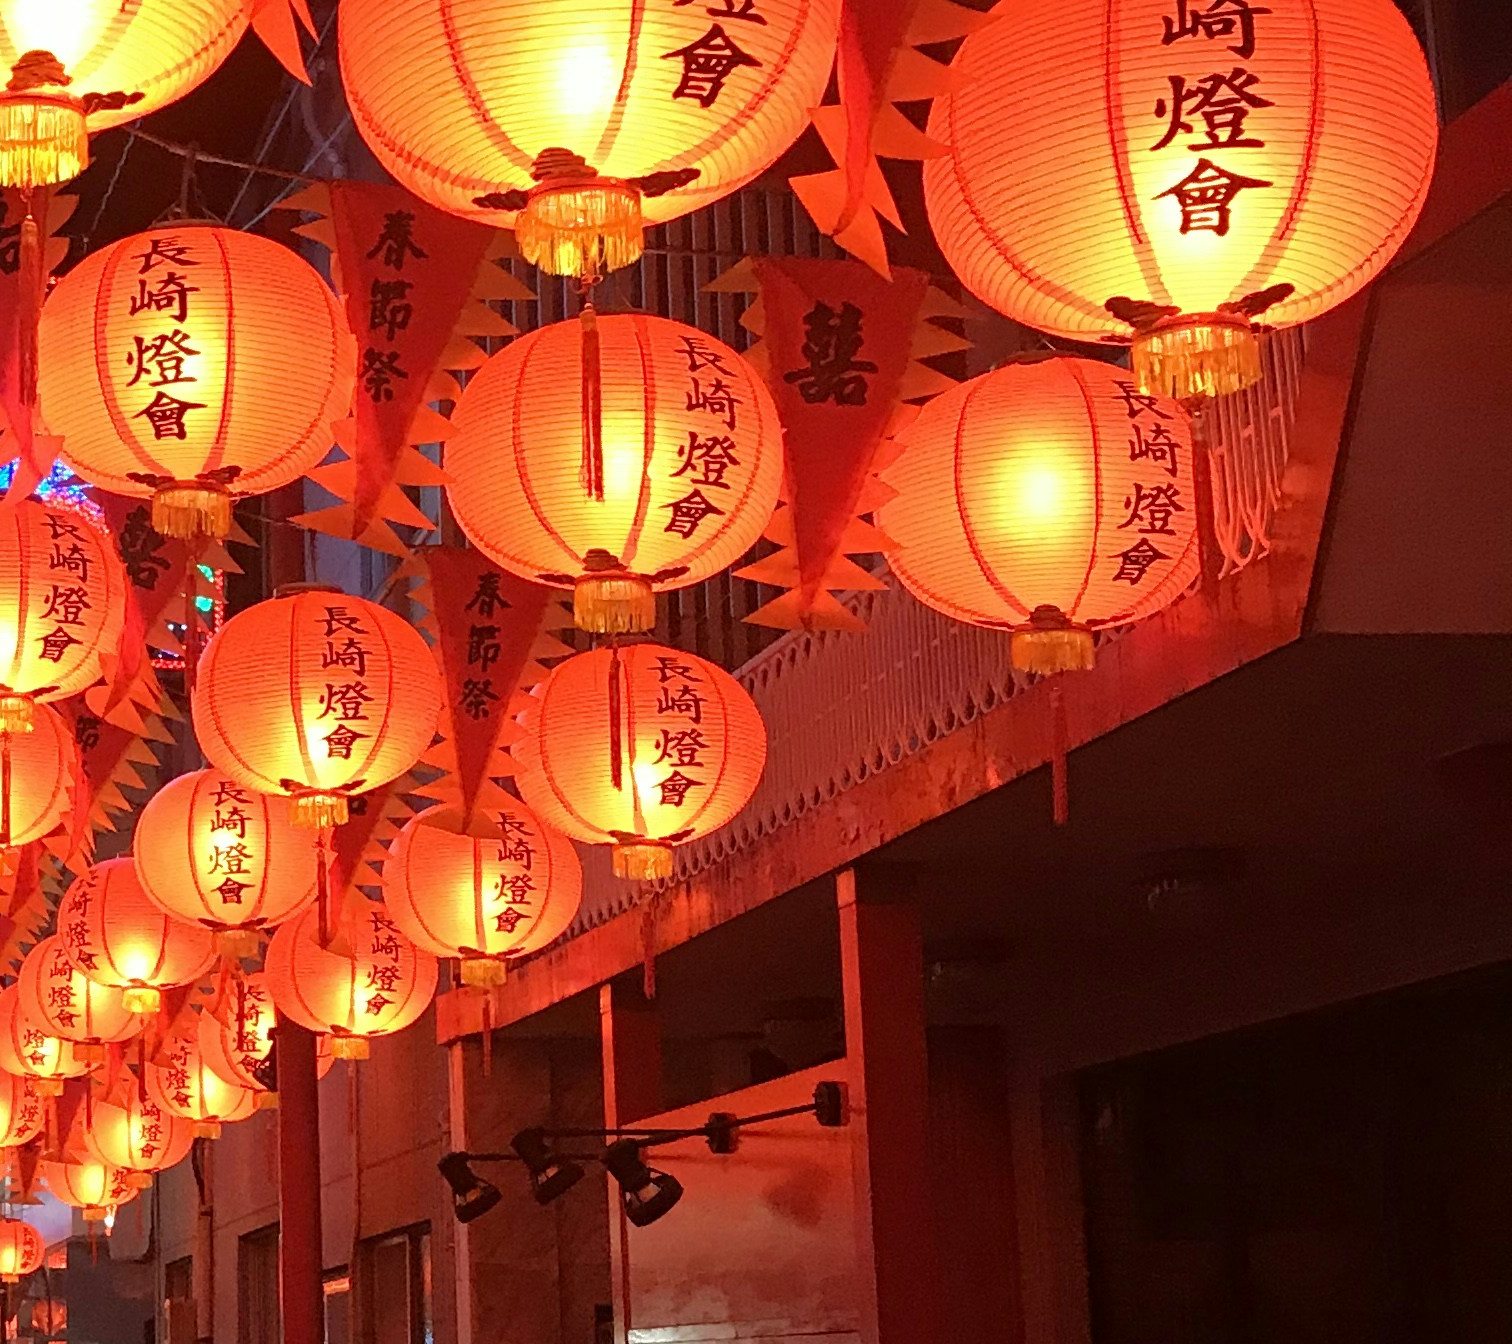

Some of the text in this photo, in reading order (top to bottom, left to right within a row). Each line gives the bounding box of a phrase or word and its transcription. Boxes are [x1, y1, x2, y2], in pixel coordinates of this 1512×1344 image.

[125, 237, 209, 441] 長崎燈會
[361, 208, 429, 403] 春節祭
[659, 334, 745, 540] 長崎燈會
[1111, 379, 1187, 586] 長崎燈會
[38, 513, 92, 664] 長崎燈會
[459, 573, 512, 720] 春節祭
[315, 607, 375, 760] 長崎燈會
[647, 657, 710, 807] 長崎燈會
[208, 781, 256, 905] 長崎燈會
[493, 812, 537, 935] 長崎燈會
[49, 949, 81, 1028] 崎燈會
[365, 911, 404, 1016] 長崎燈會
